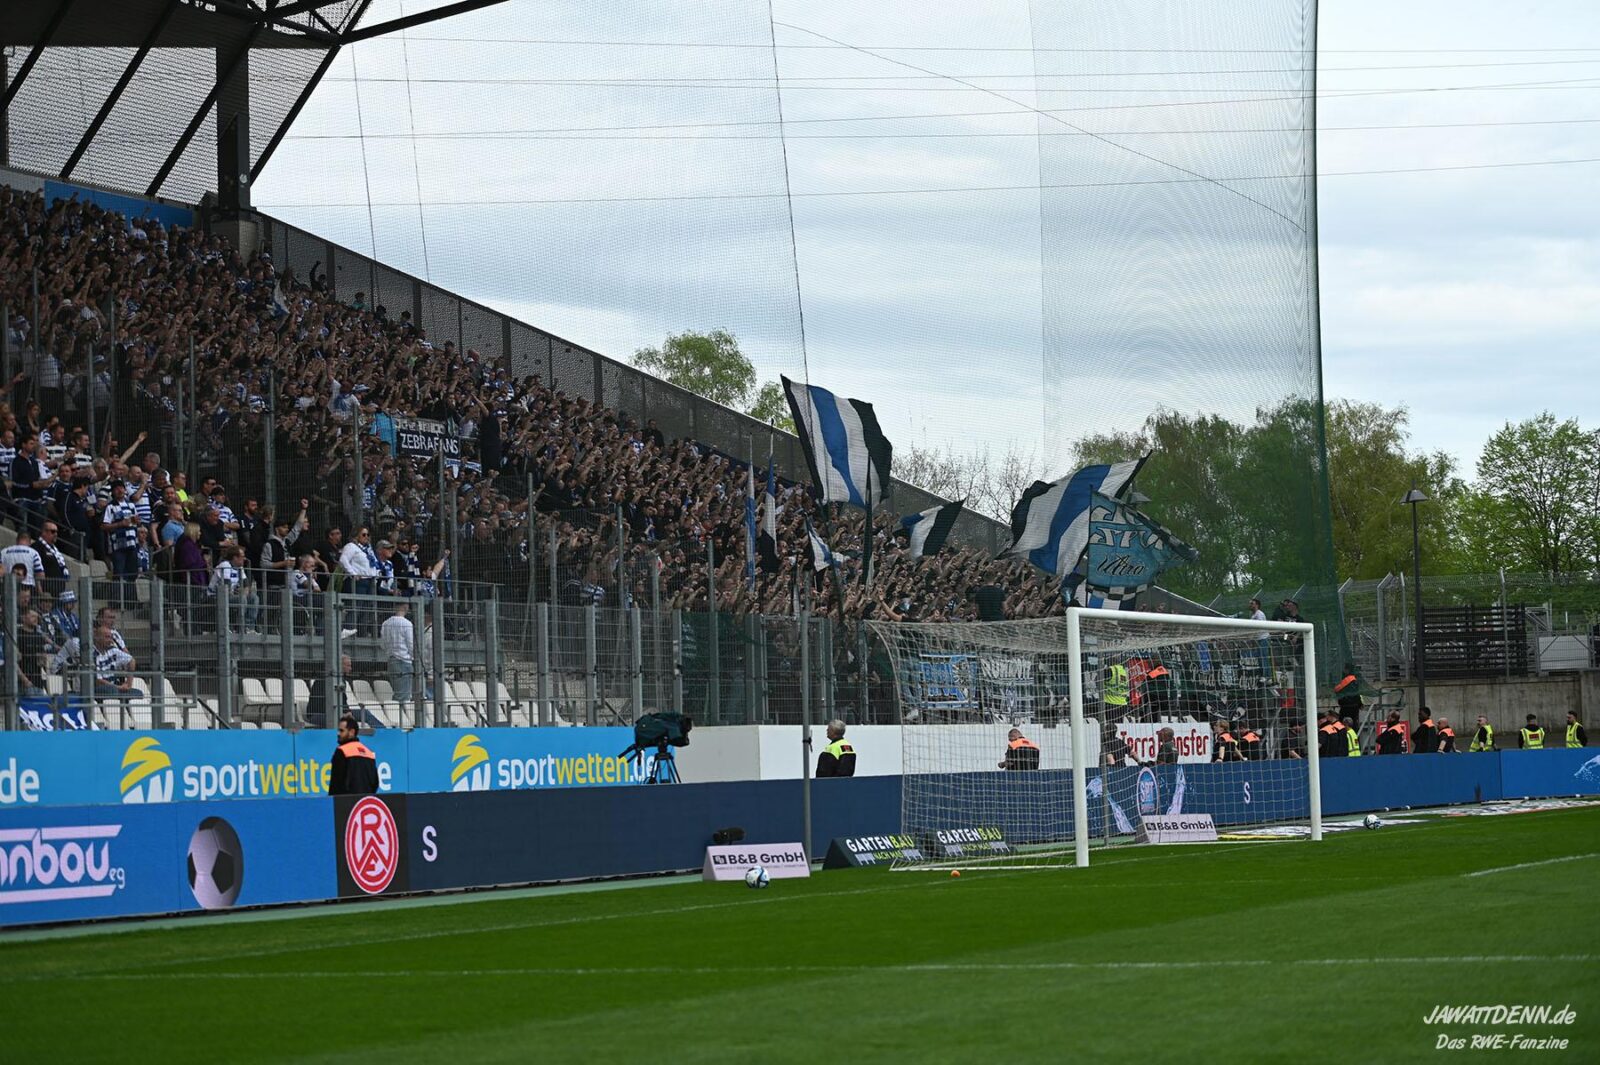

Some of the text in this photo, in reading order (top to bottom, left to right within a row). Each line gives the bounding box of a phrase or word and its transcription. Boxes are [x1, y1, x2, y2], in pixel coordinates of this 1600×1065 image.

[1243, 781, 1250, 804] S
[1158, 820, 1213, 831] B&B GmbH
[422, 825, 438, 862] S
[846, 835, 915, 853] GARTENBAU
[937, 828, 1002, 844] GARTENBAU
[728, 852, 804, 865] B&B GmbH
